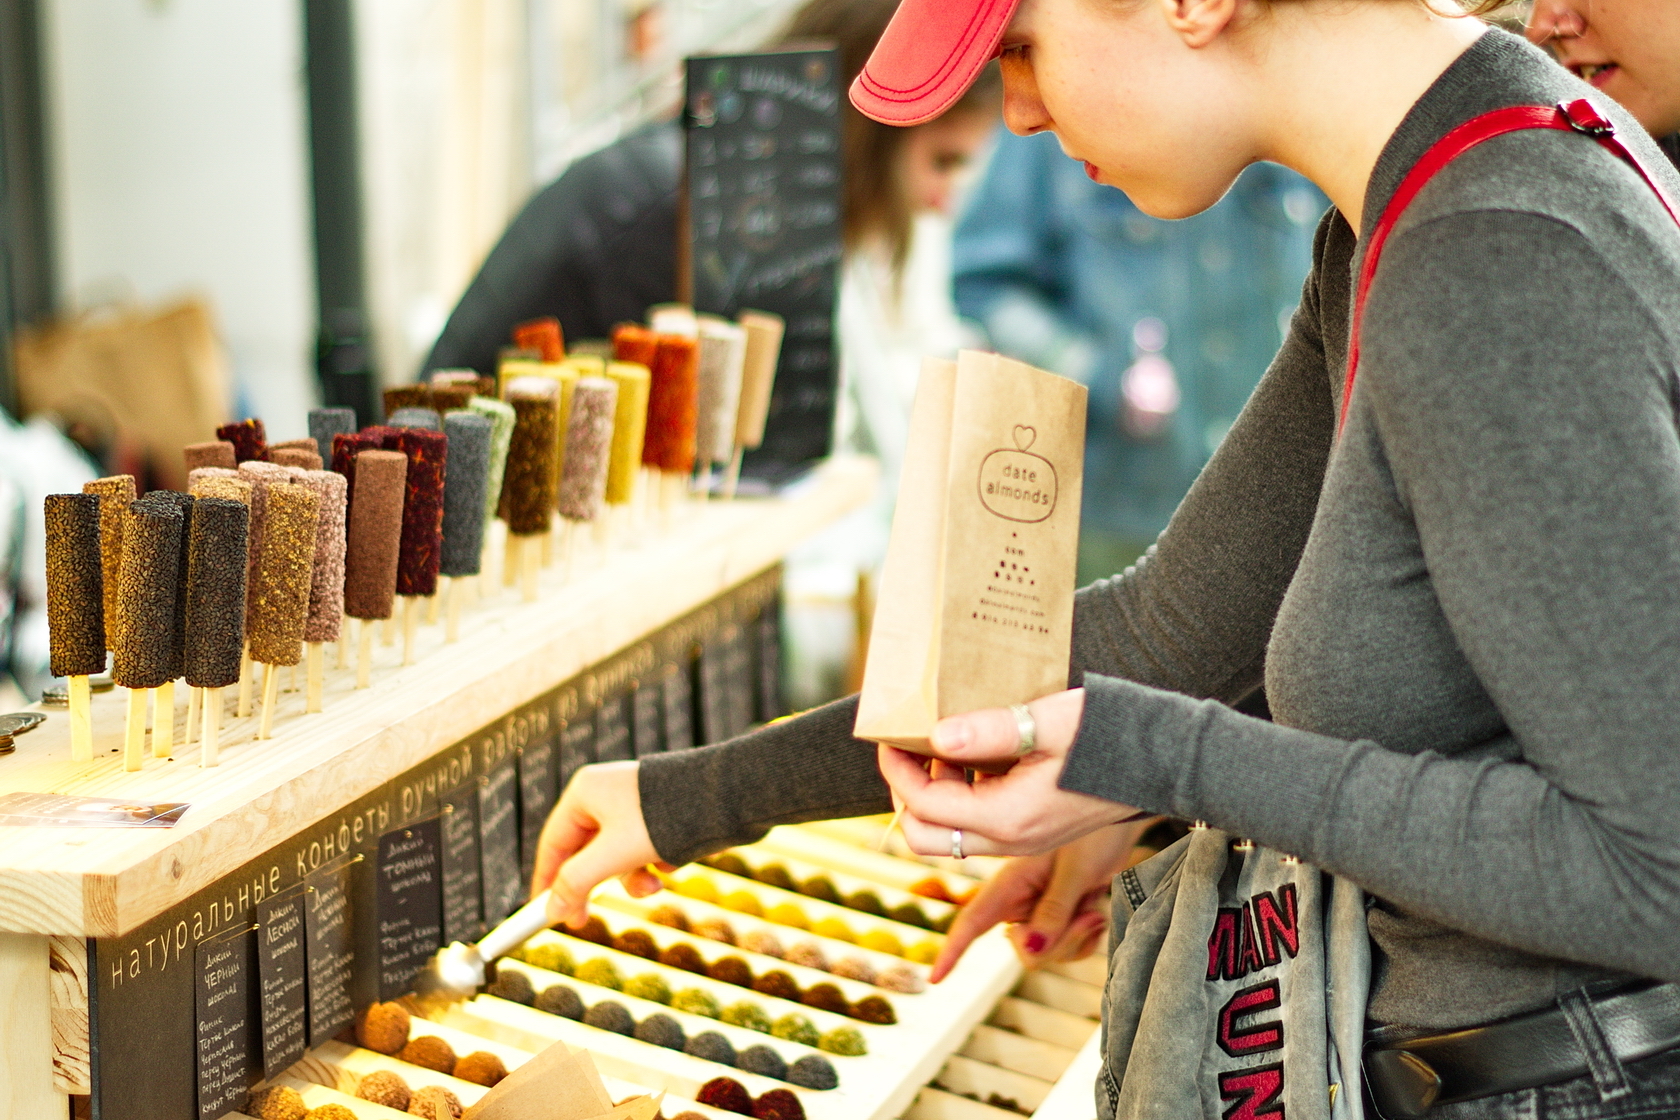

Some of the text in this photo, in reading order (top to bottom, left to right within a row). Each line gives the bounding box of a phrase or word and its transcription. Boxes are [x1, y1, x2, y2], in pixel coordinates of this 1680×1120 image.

[1002, 463, 1037, 483] date
[986, 481, 1049, 505] almonds
[111, 866, 280, 989] натуральные
[297, 802, 389, 876] конфеты
[402, 745, 472, 822] ручной
[266, 909, 300, 946] ЛЕСНОЙ
[205, 943, 232, 969] Дикий
[204, 954, 240, 989] ЧЕРНЫЙ
[199, 1016, 223, 1034] Финик
